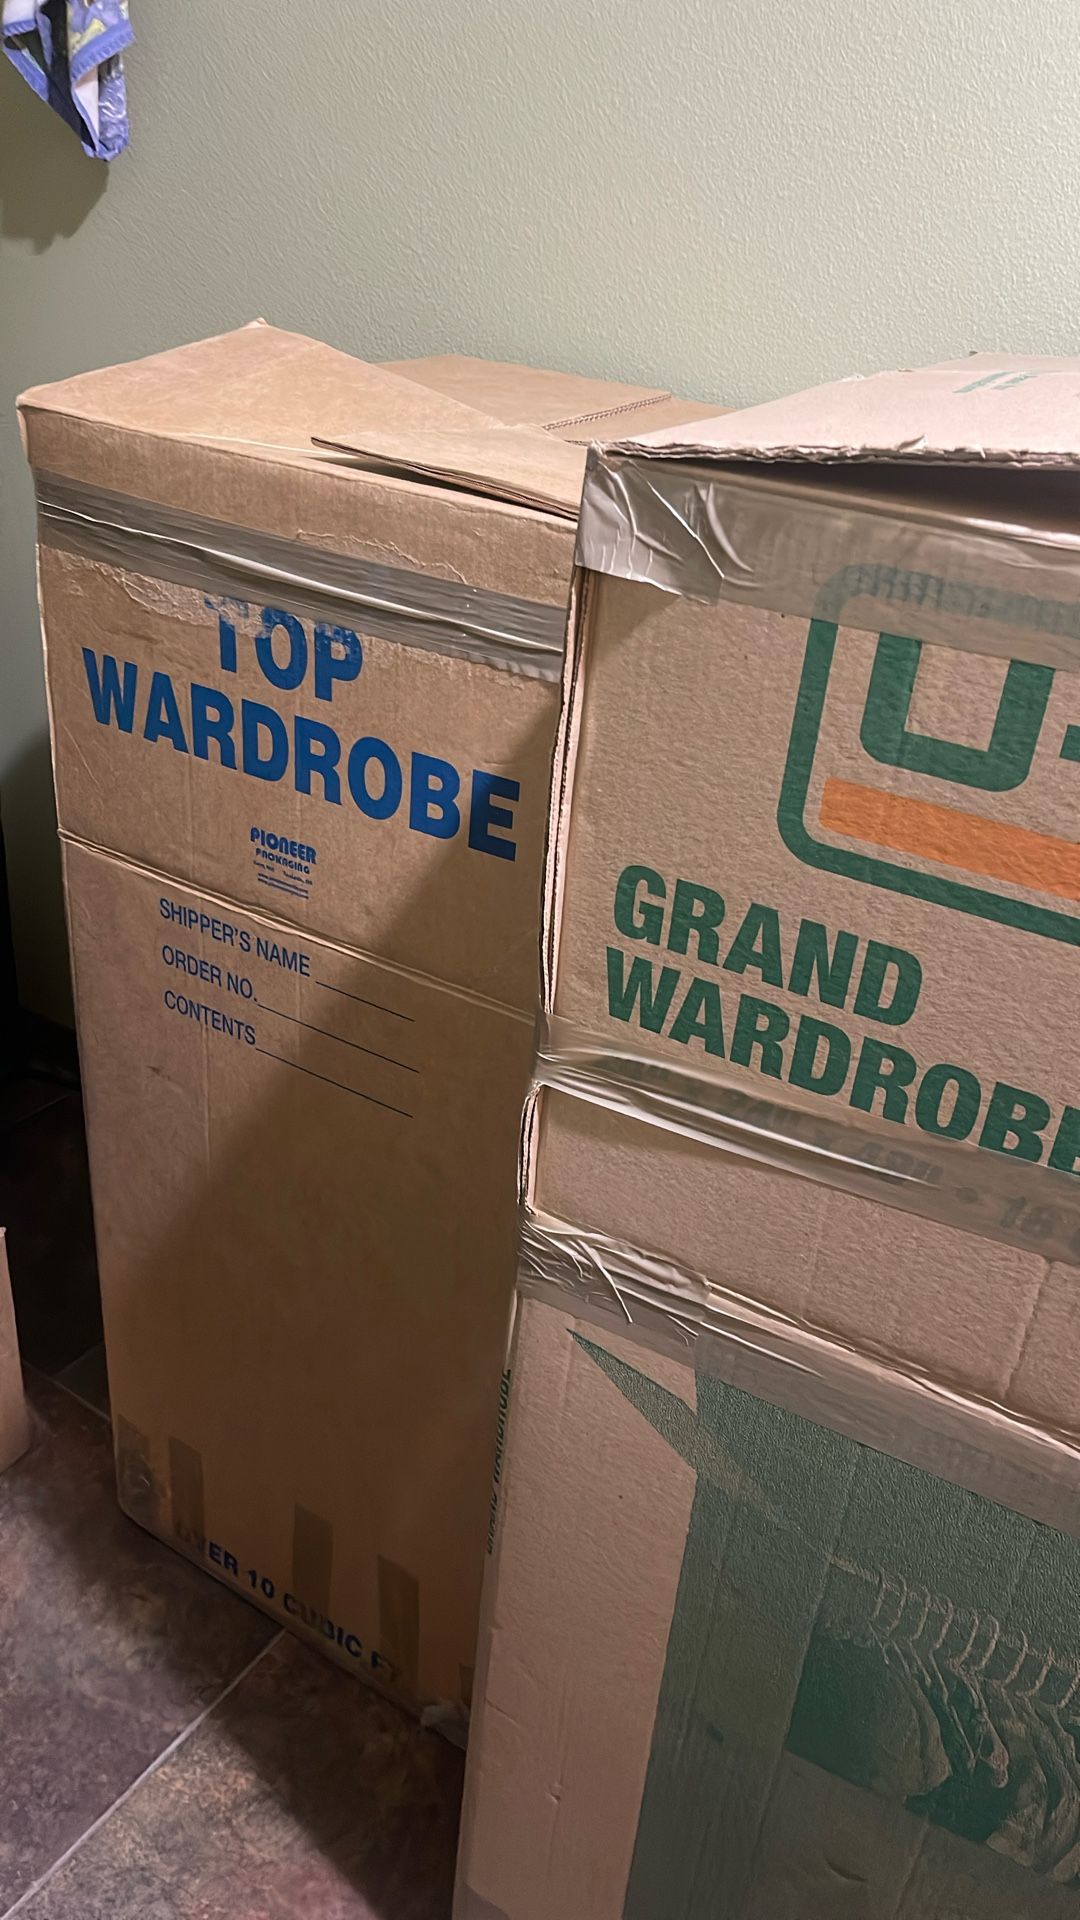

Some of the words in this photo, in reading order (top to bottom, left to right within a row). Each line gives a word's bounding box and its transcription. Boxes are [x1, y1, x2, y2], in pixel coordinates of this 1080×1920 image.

[204, 596, 362, 702] TOP
[82, 647, 520, 862] WARDROBE
[250, 827, 317, 864] PIONEER
[255, 848, 310, 874] PACKAGING
[159, 898, 251, 952] SHIPPER'S
[256, 937, 311, 977] NAME
[613, 865, 923, 1026] GRAND
[162, 945, 222, 987] ORDER
[227, 972, 258, 1002] NO.
[164, 990, 256, 1045] CONTENTS
[248, 1568, 276, 1600] 10
